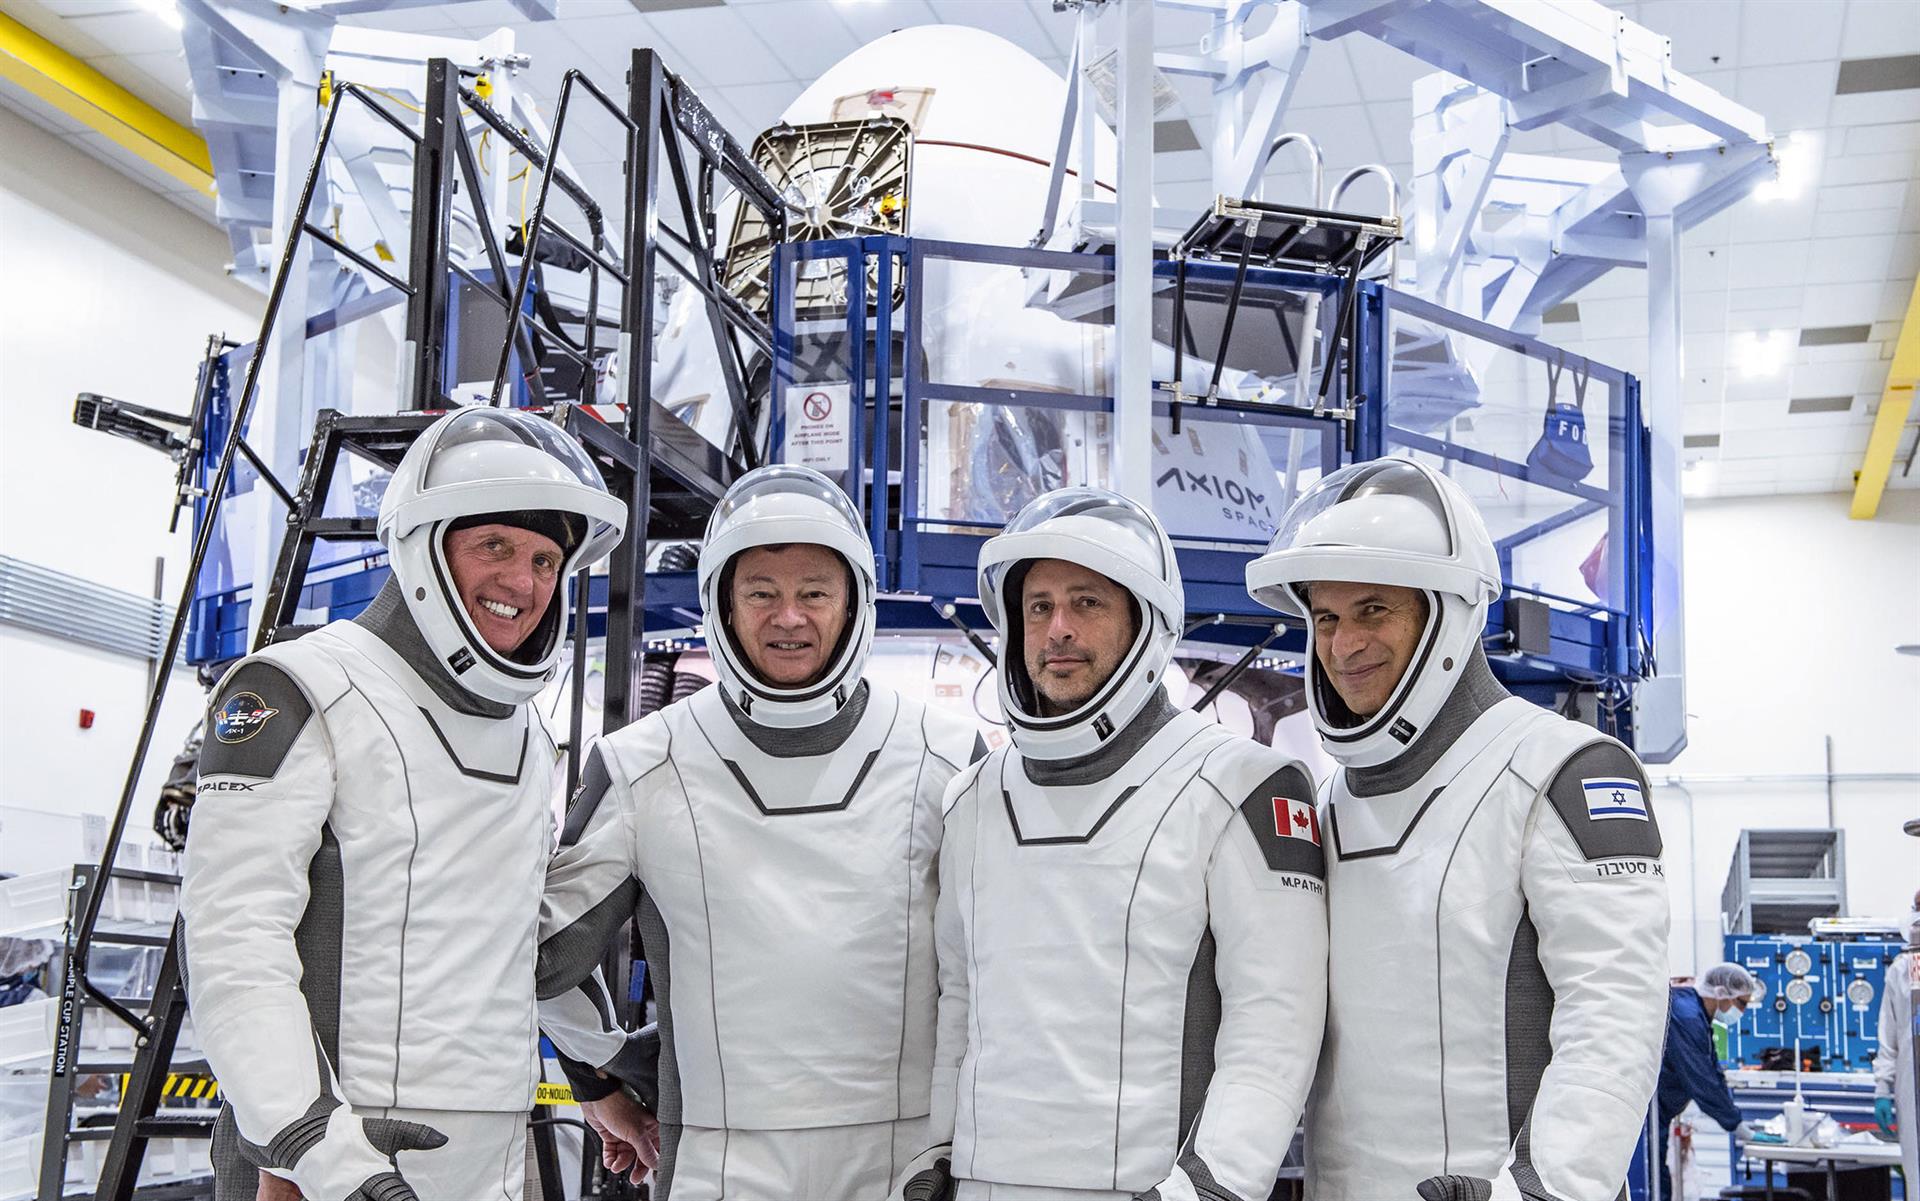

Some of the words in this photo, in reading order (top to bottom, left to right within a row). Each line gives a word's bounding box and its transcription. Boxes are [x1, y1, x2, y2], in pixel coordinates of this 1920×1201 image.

[1156, 467, 1271, 518] AXIOM
[197, 781, 274, 795] SPACEX
[1596, 862, 1647, 876] סטיבה
[62, 1001, 73, 1023] CUP
[55, 1025, 70, 1073] STATION
